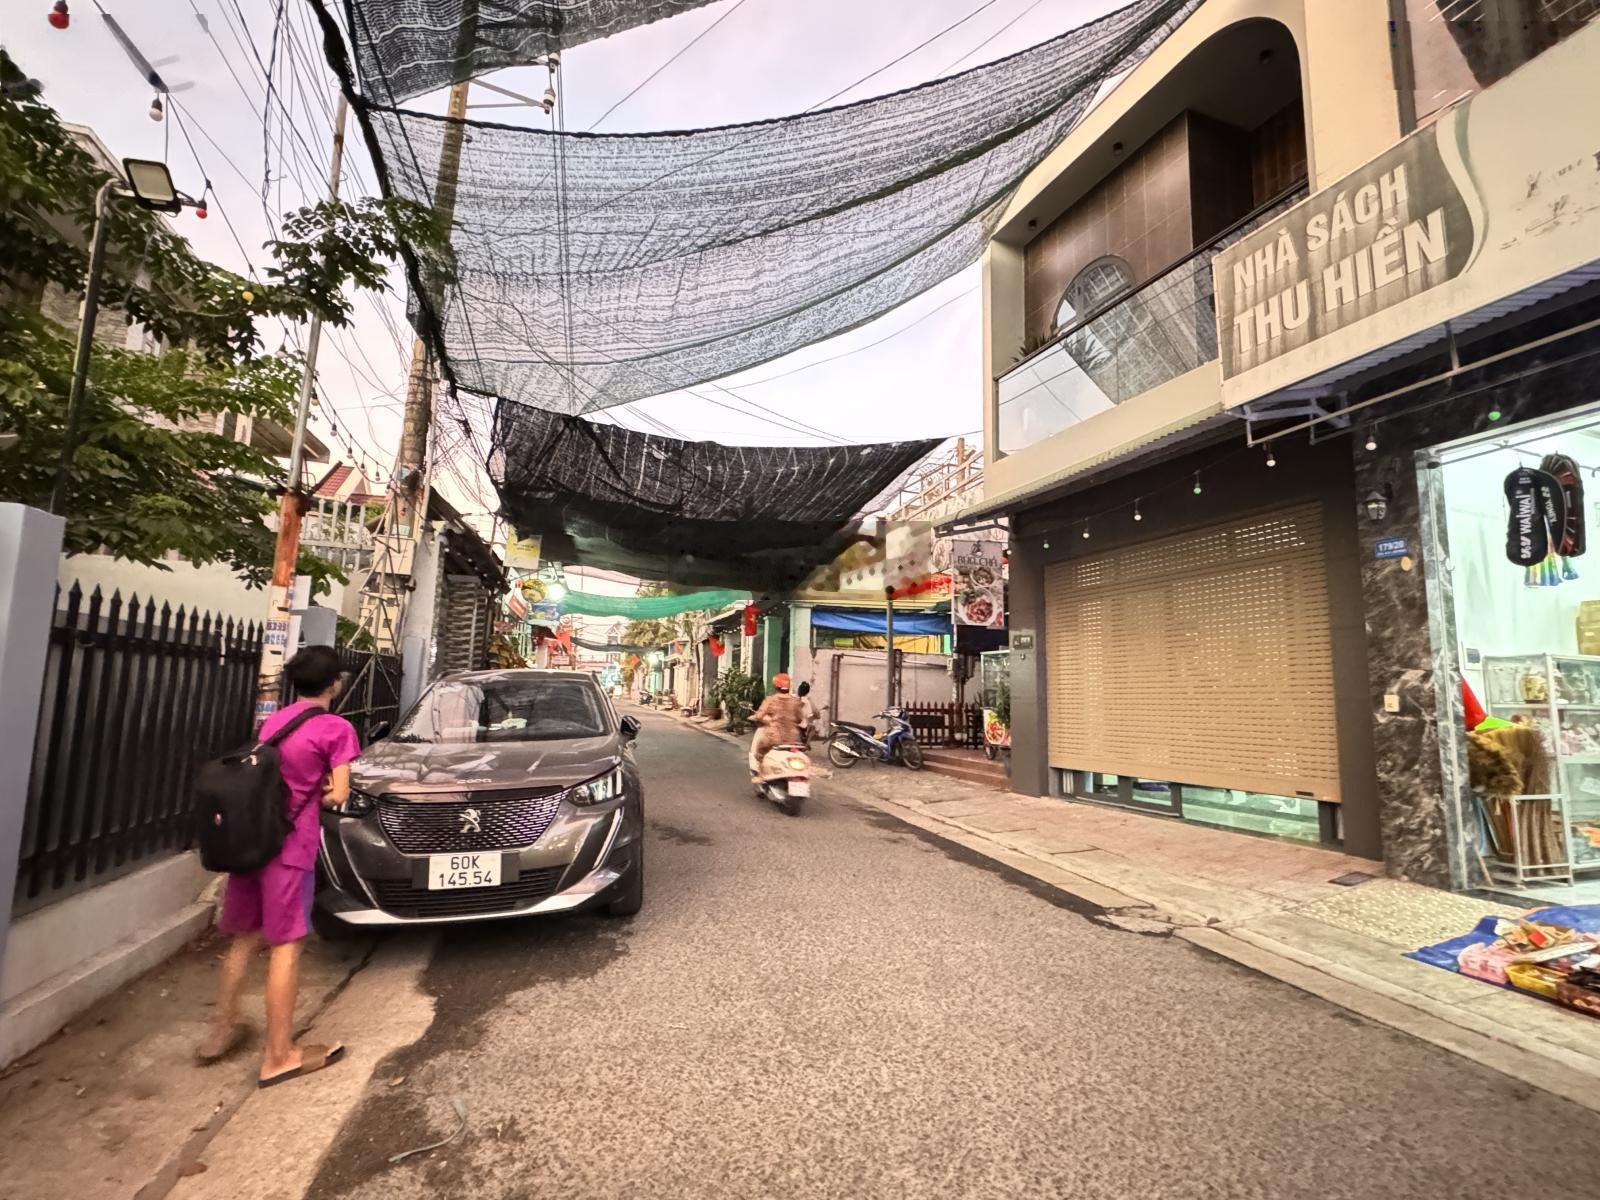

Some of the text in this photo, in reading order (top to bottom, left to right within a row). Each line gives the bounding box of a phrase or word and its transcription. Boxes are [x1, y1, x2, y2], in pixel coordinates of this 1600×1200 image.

[1232, 226, 1299, 295] NHÀ
[1305, 162, 1408, 252] SÁCH
[1233, 207, 1449, 354] THU HIỀN
[438, 871, 493, 888] 145.54
[450, 855, 480, 870] 60K
